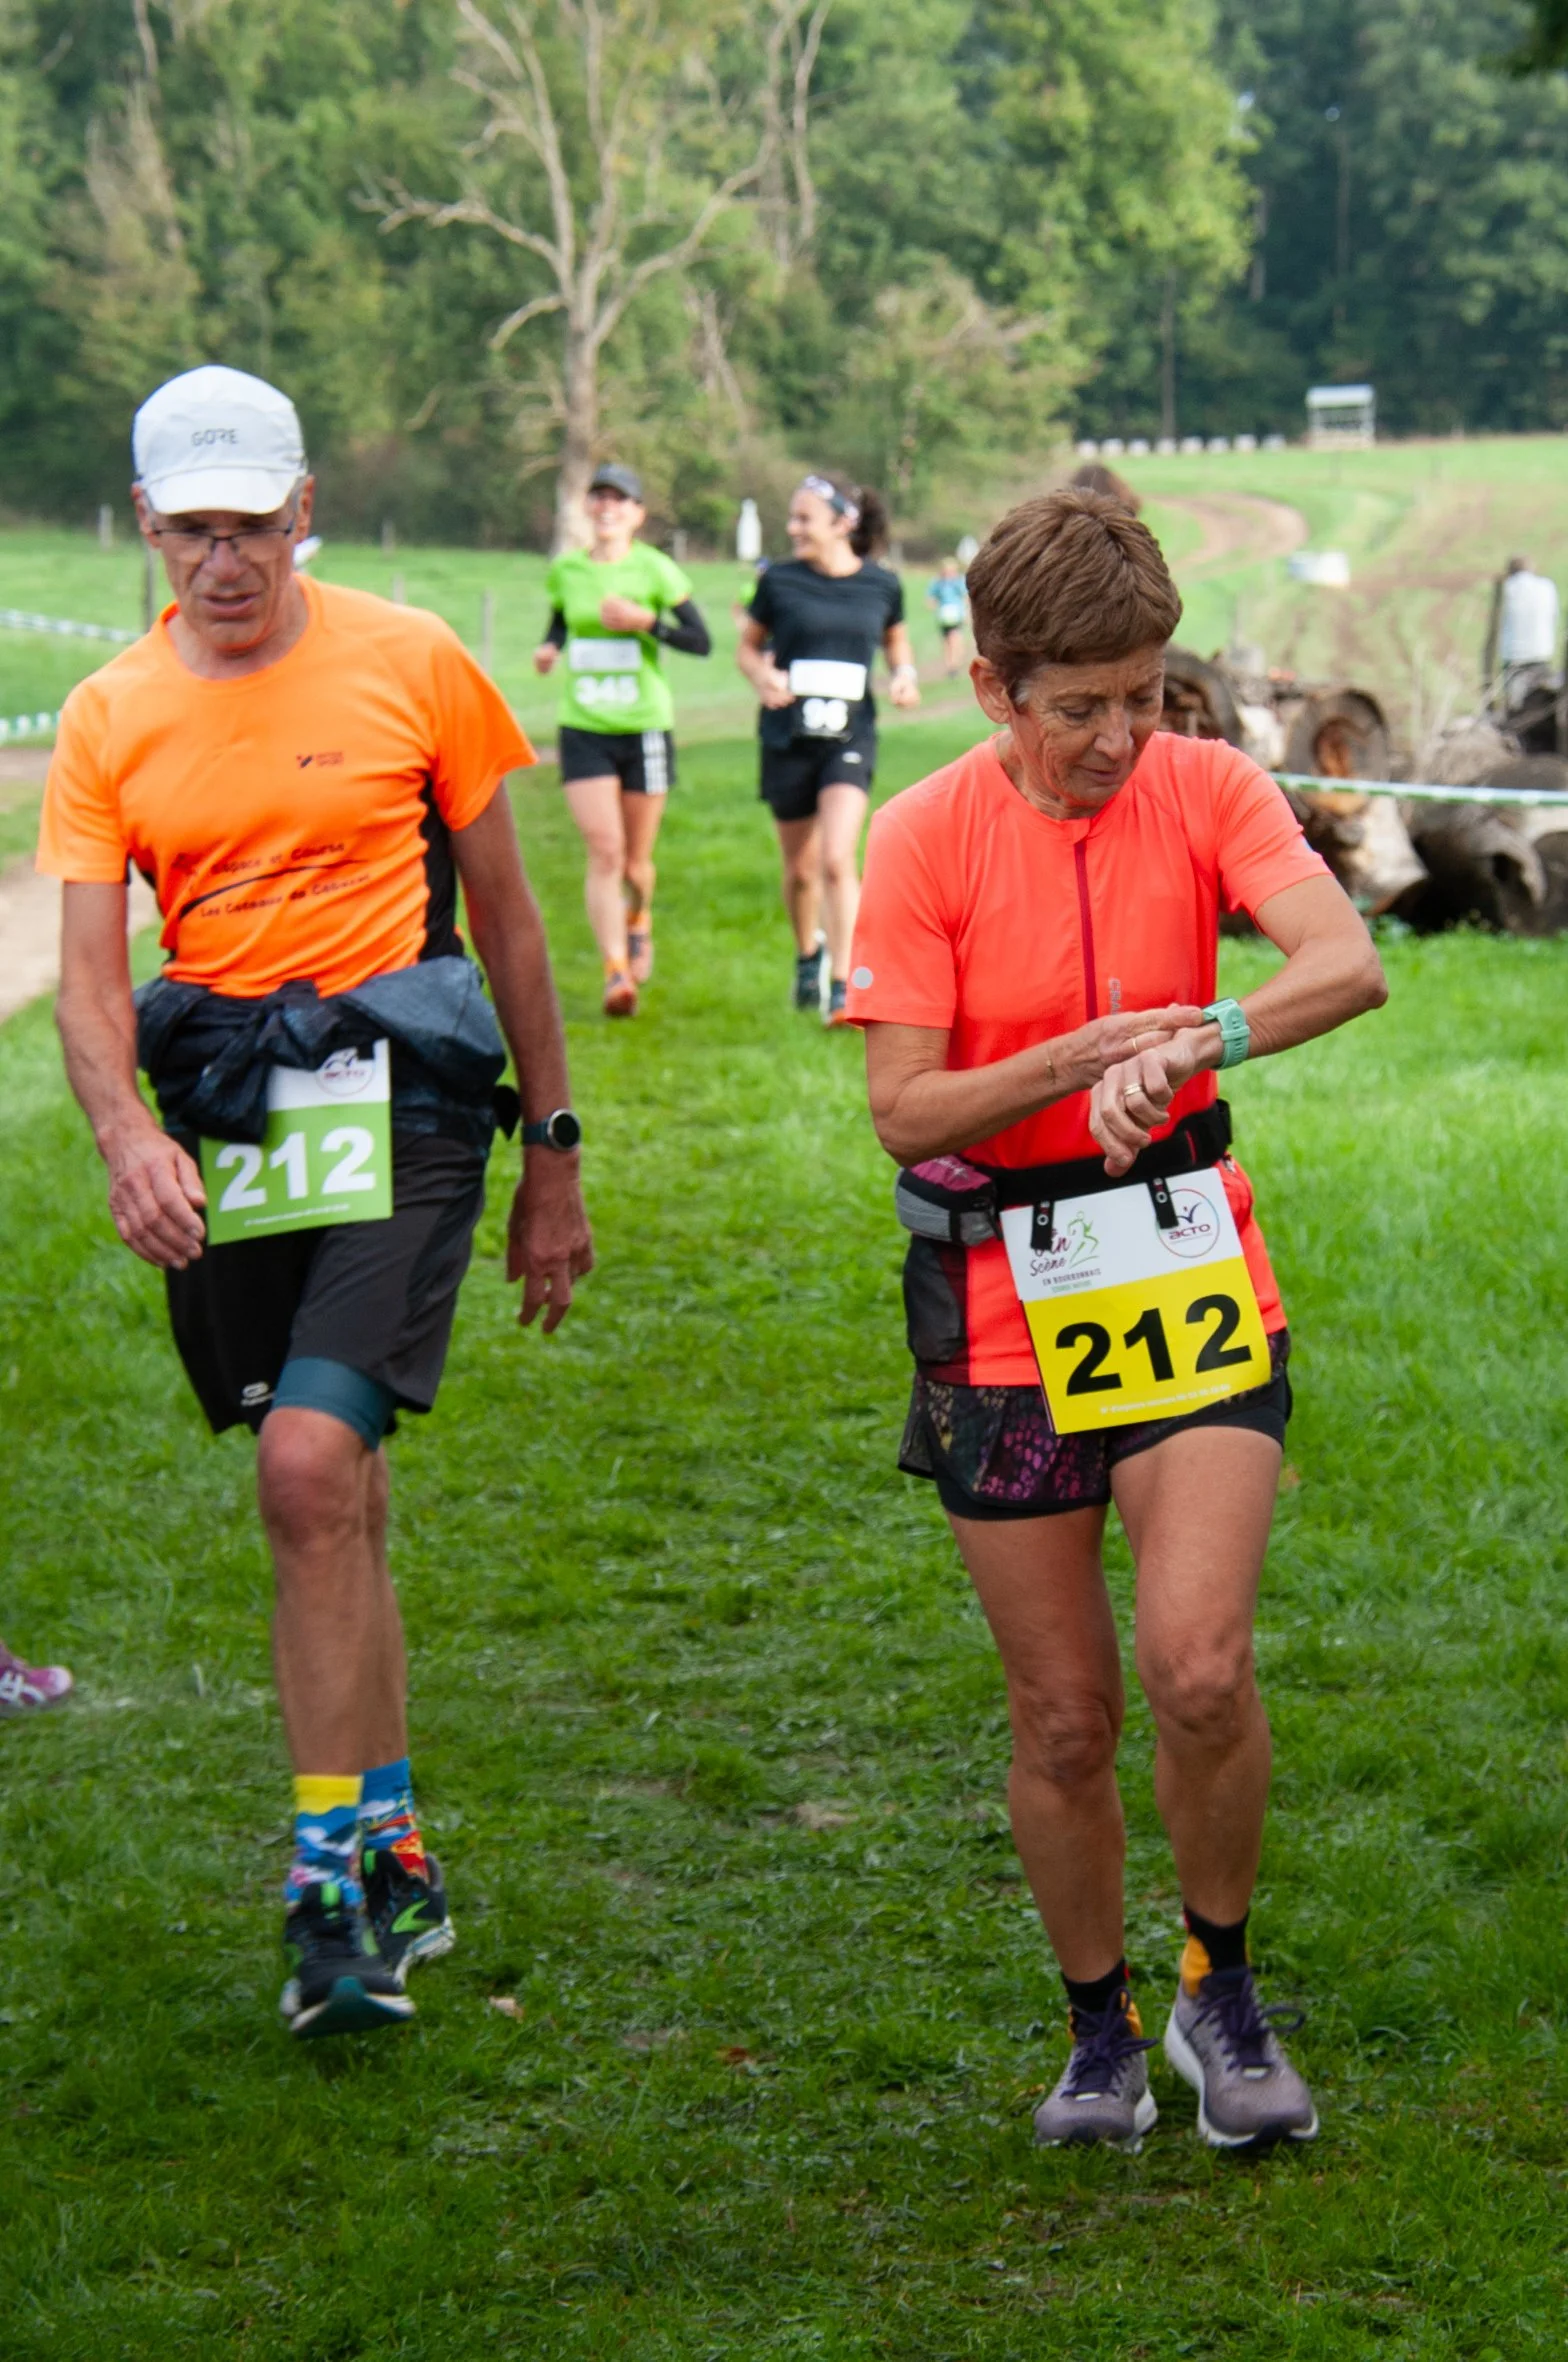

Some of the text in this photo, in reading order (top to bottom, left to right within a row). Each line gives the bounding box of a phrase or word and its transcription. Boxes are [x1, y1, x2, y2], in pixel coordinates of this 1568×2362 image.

[191, 428, 239, 447] GORE
[214, 1125, 377, 1213] 212
[1055, 1293, 1253, 1397] 212
